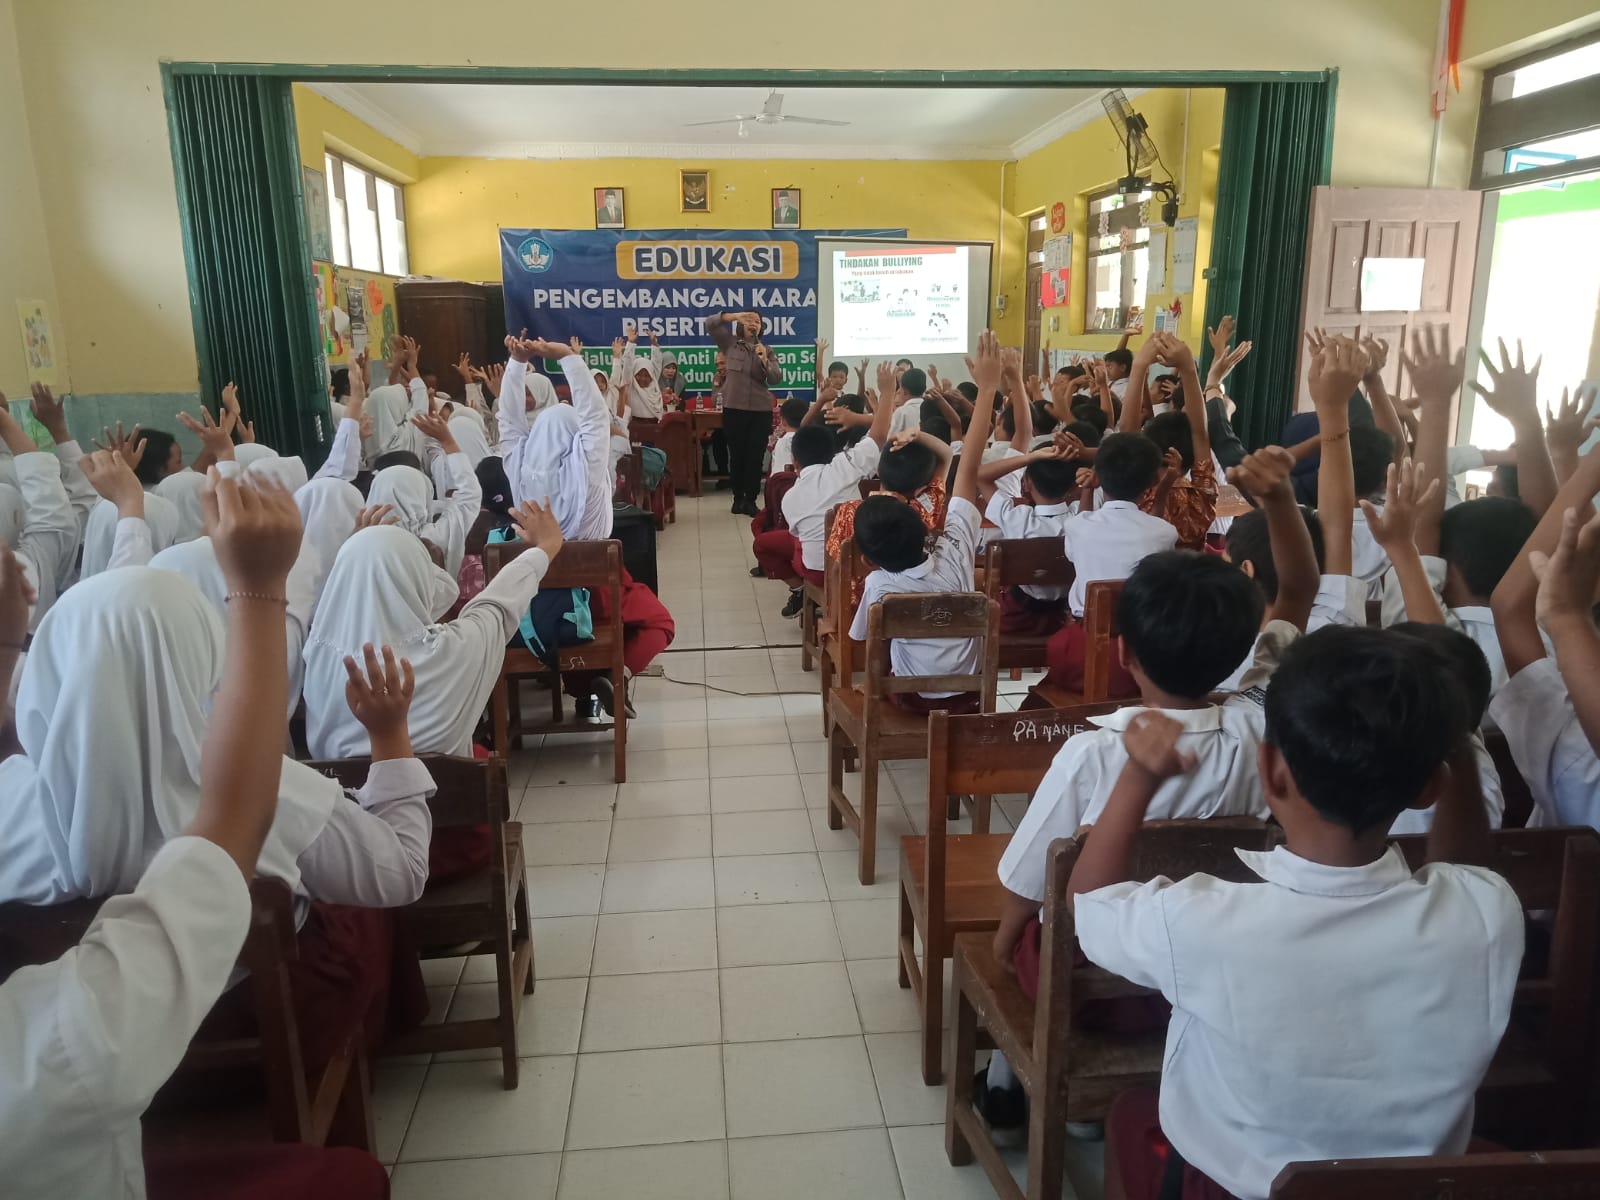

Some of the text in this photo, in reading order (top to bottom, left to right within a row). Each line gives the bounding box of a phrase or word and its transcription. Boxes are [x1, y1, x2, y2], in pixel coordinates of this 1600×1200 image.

[634, 246, 781, 274] EDUKASI
[839, 256, 923, 269] TINDAKAN BULLIYING
[534, 287, 816, 309] PENGEMBANGAN KARA
[622, 317, 710, 337] PESERT
[677, 349, 710, 365] Anti
